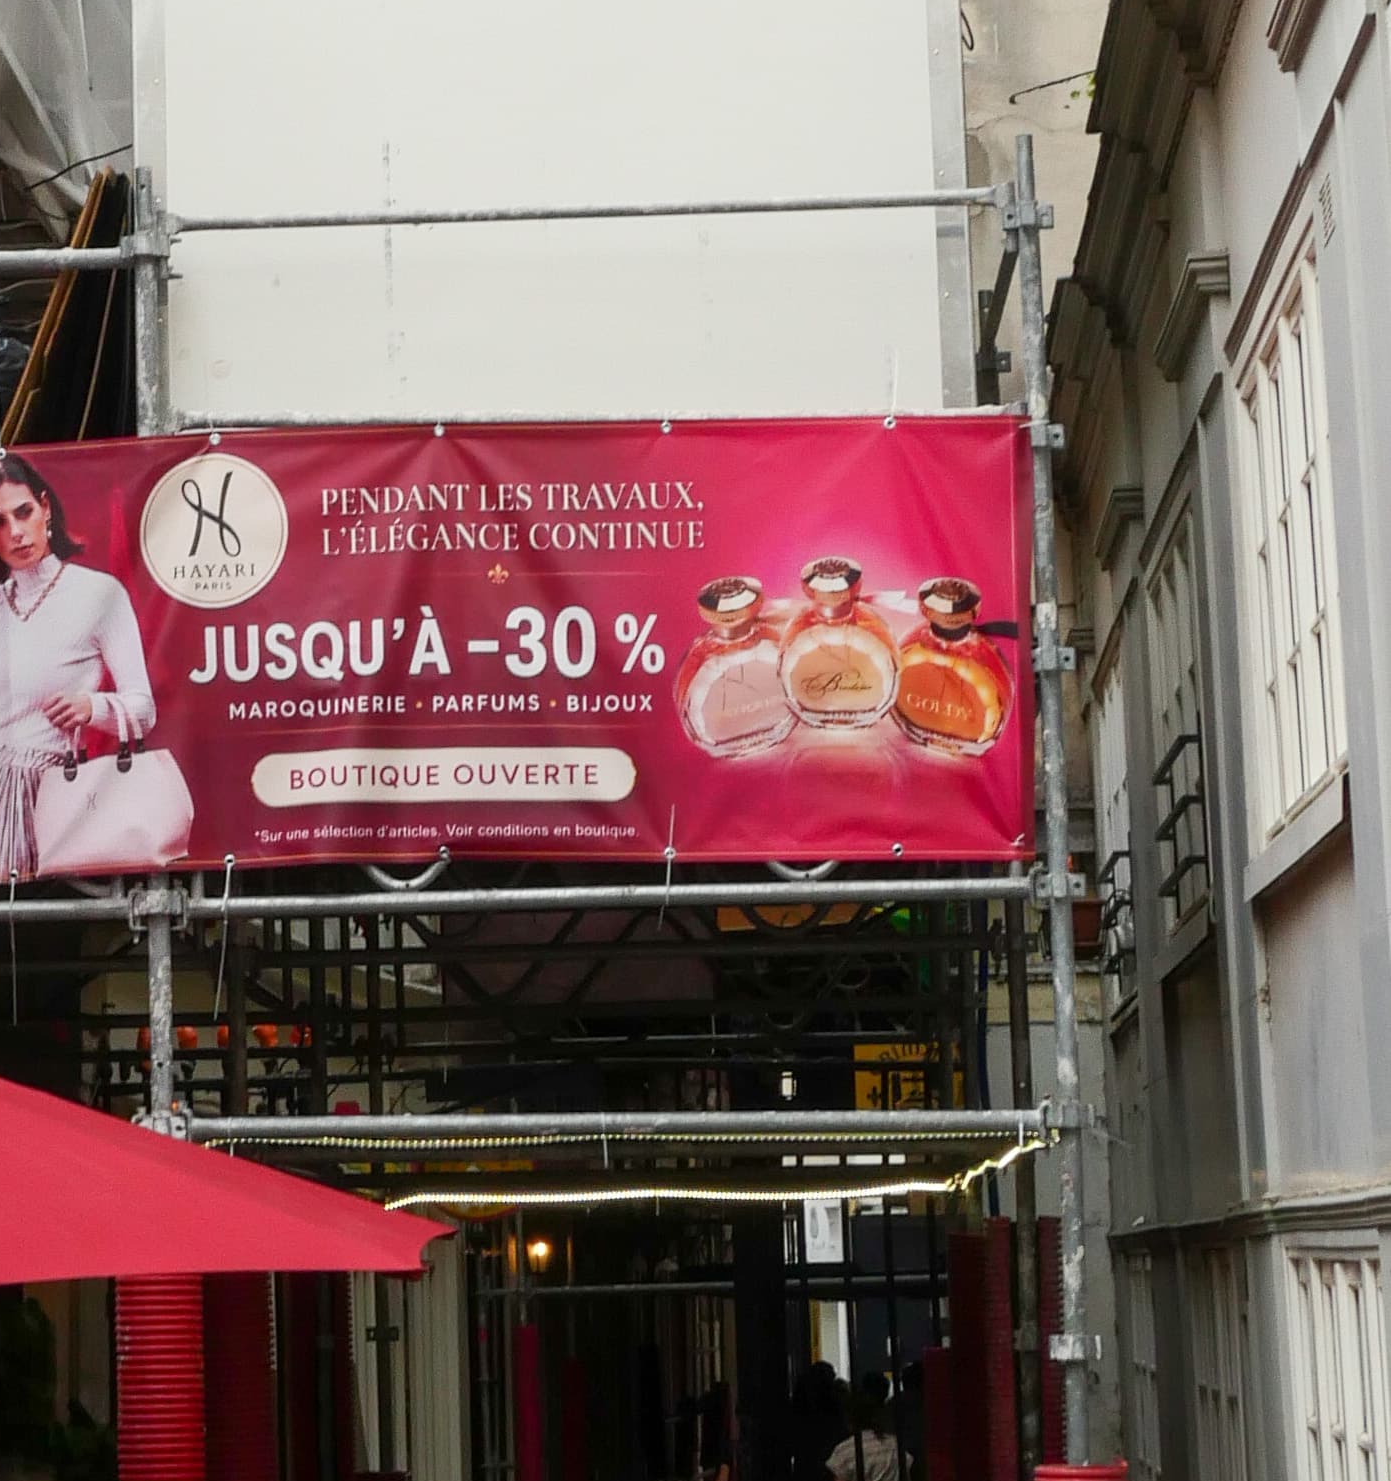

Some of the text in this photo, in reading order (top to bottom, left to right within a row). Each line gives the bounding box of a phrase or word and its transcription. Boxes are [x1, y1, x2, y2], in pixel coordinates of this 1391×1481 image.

[320, 481, 705, 517] PENDANT LES TRAVAUX,
[321, 515, 705, 557] L'ÉLÉGANCE CONTINUE
[172, 561, 256, 581] HAYARI
[194, 580, 233, 592] PARIS
[188, 605, 451, 685] JUSQU'À
[229, 693, 654, 721] MAROQUINERIE PARFUMS BIJOUX
[289, 763, 600, 791] BOUTIQUE OUVERTE
[285, 829, 309, 840] une
[313, 823, 373, 840] sélection
[445, 823, 475, 839] Voir
[477, 822, 551, 839] conditions
[553, 826, 571, 838] en
